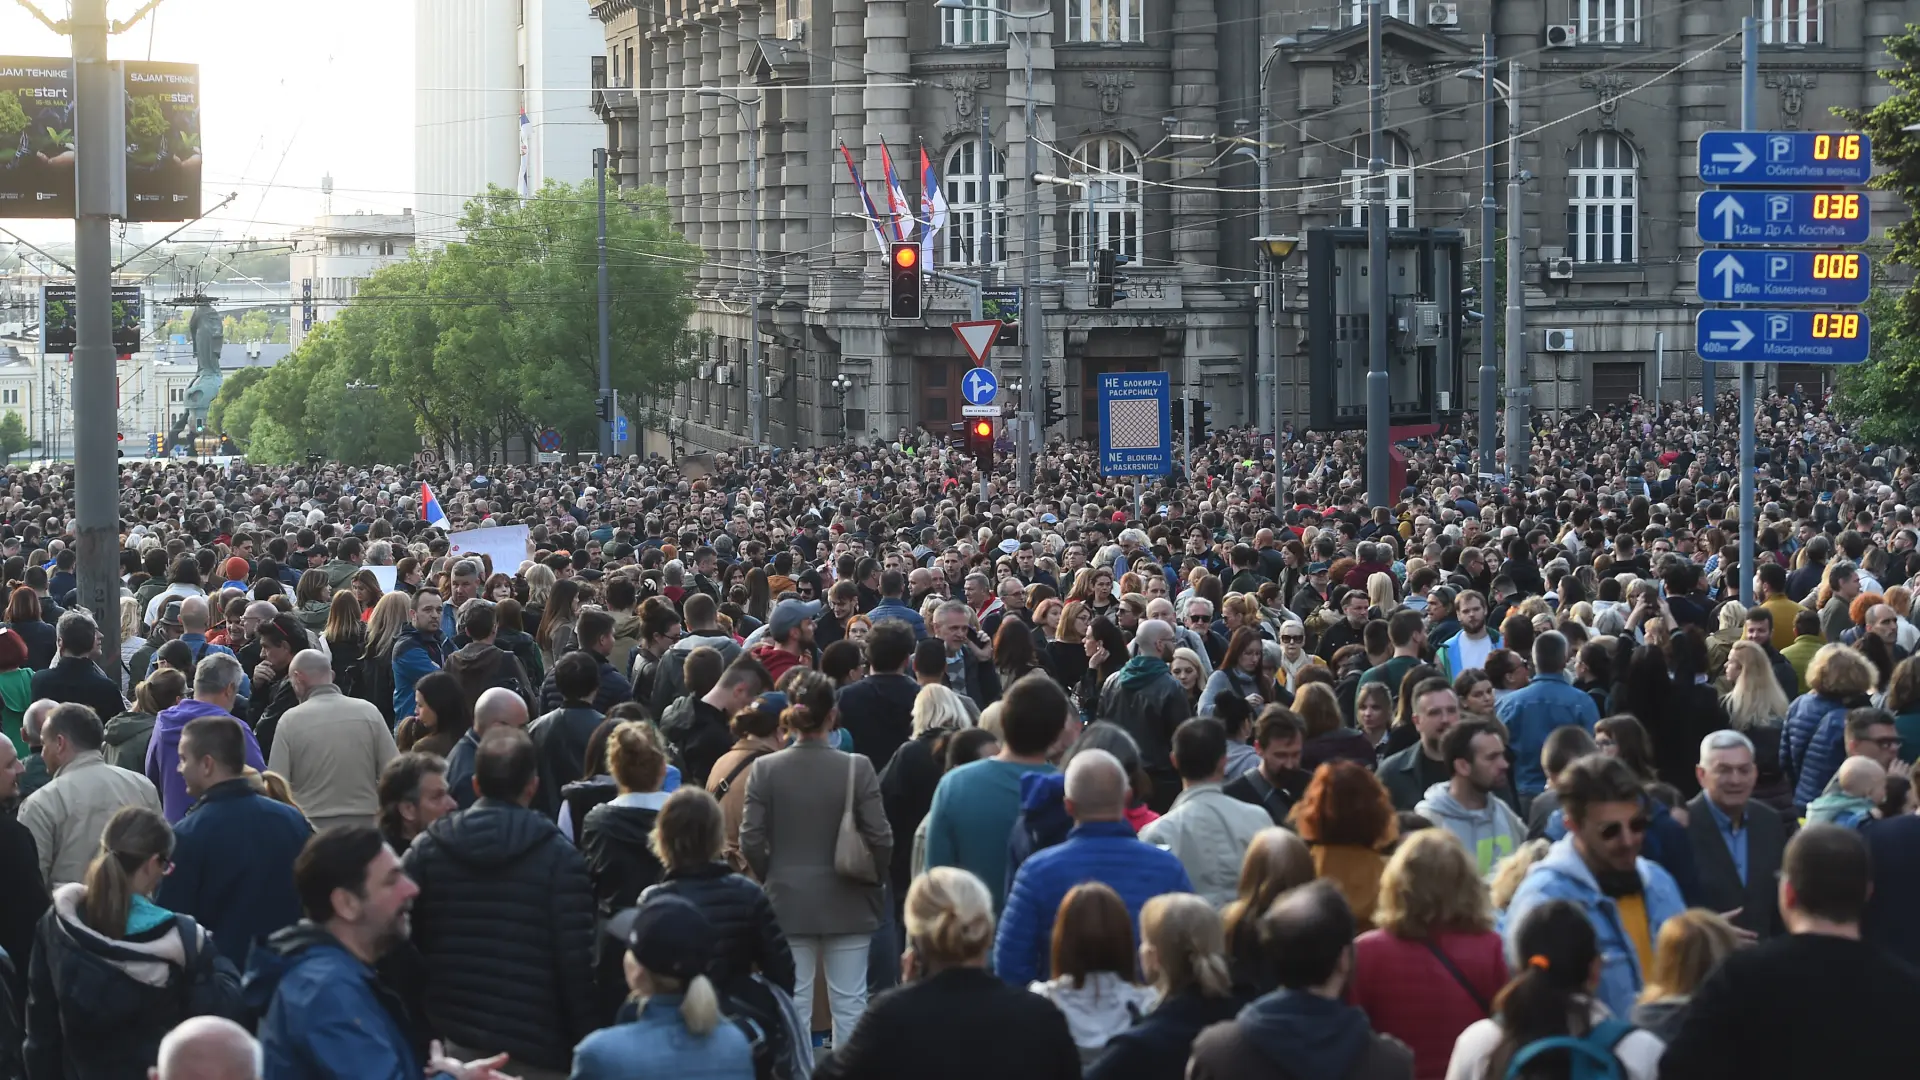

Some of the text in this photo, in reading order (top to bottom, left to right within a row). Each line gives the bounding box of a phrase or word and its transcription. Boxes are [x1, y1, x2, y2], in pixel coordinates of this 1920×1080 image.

[0, 68, 68, 78] JAM TEHNIKE
[130, 73, 195, 84] SAJAM TEHNIKE
[18, 86, 68, 98] restart
[159, 92, 194, 103] restart
[1814, 135, 1860, 160] 016
[1766, 165, 1860, 178] Обилићев венац
[1813, 194, 1859, 219] 036
[1764, 225, 1845, 237] Др А. Костића
[1813, 254, 1859, 279] 006
[1764, 284, 1827, 295] Каменичка
[1812, 313, 1859, 339] 038
[1764, 343, 1832, 356] Масарикова
[1105, 378, 1162, 388] НЕ БЛОКИРАЈ
[1109, 388, 1158, 397] РАСКРСНИЦУ
[1109, 452, 1162, 462] NE BLOKIRAJ
[1113, 463, 1159, 471] RASKRSNICU
